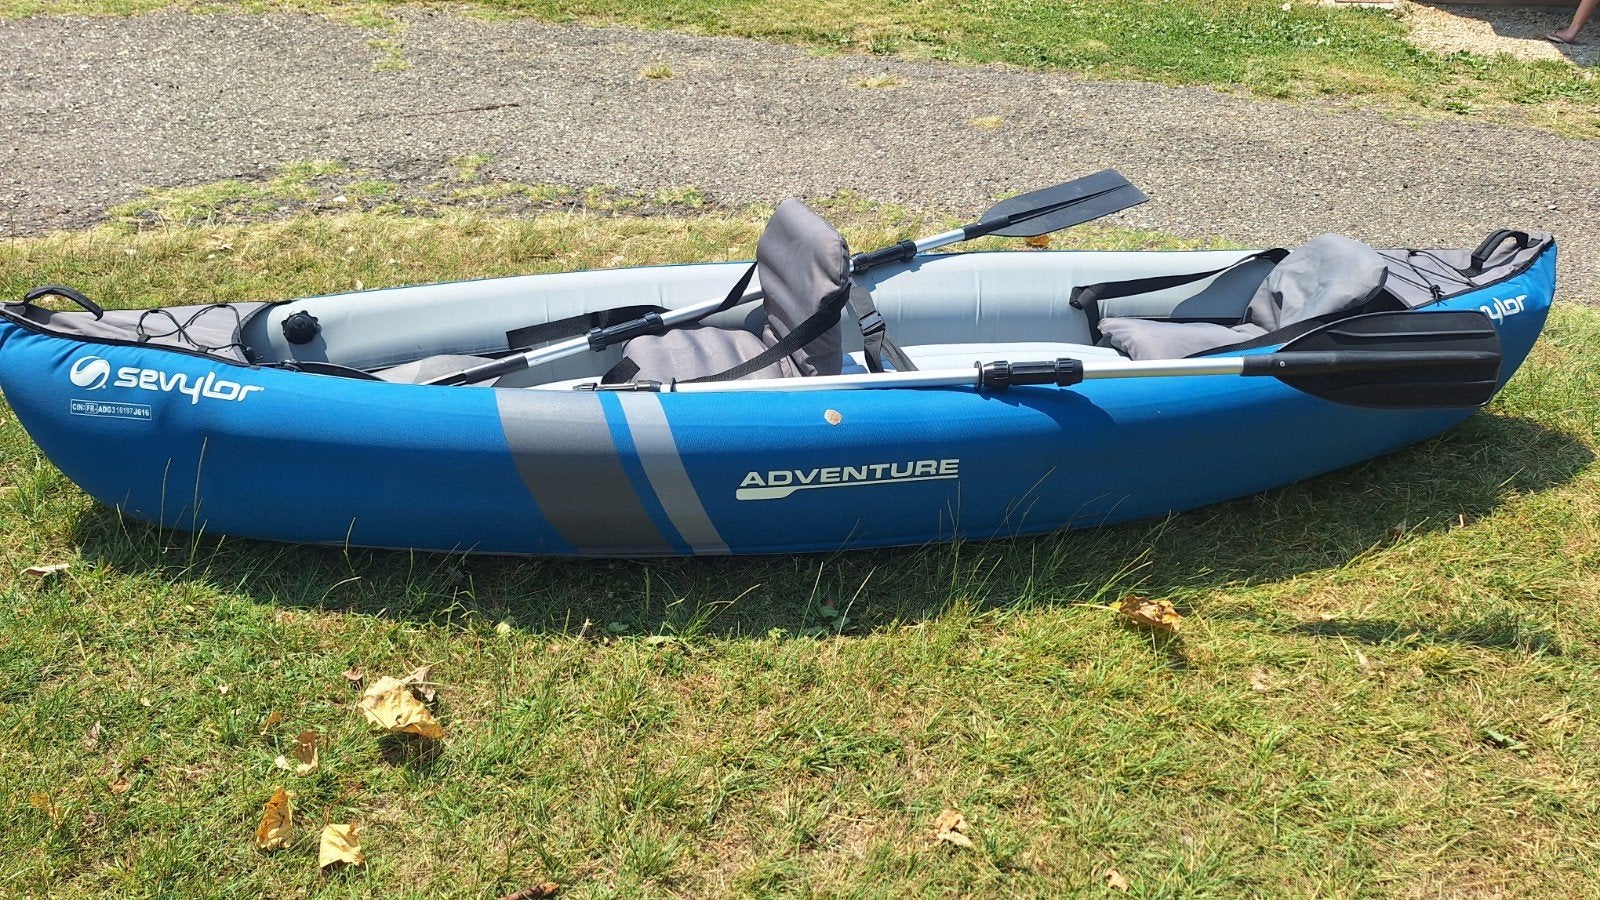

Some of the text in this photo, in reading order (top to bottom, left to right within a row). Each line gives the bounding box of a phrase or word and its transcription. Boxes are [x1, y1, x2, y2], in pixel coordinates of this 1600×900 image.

[1480, 294, 1527, 325] ylor
[114, 366, 263, 404] sevylor
[739, 458, 960, 487] ADVENTURE
